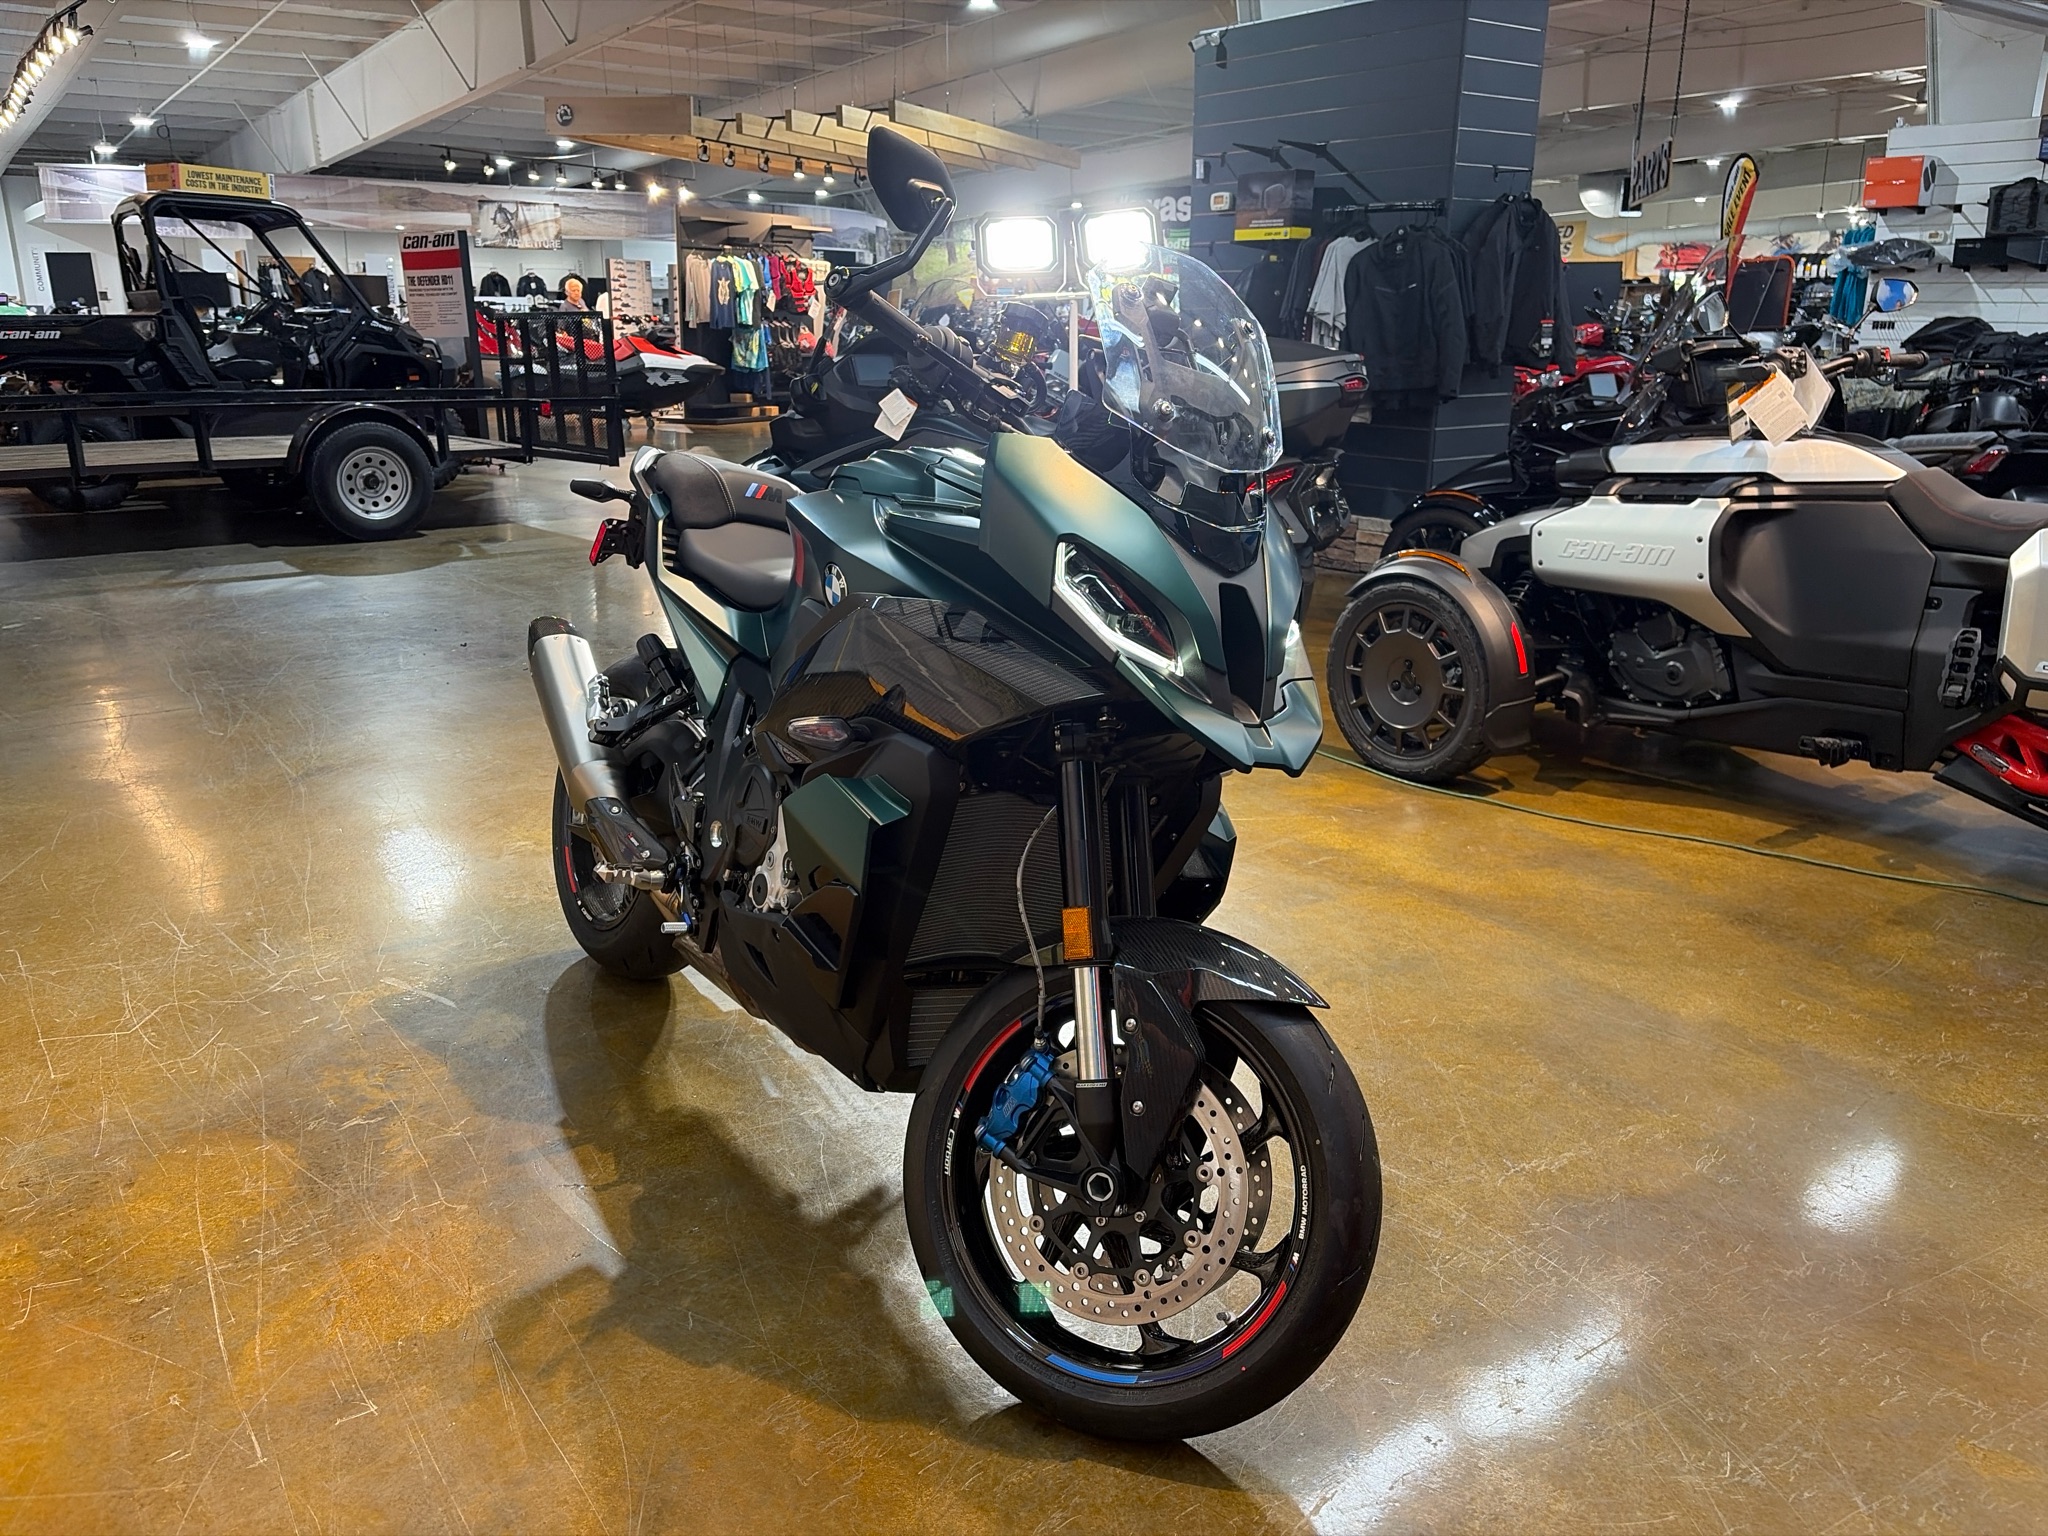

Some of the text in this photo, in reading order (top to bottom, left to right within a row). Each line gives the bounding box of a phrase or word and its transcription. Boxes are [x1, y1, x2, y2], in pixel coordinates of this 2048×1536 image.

[187, 170, 262, 186] LOWEST MAINTENANCE
[1630, 140, 1672, 202] PARTS
[185, 179, 208, 189] COSTS
[208, 181, 216, 190] IN
[217, 182, 231, 191] THE
[231, 183, 265, 195] INDUSTRY.
[1724, 167, 1752, 237] SALE EVENT
[403, 233, 456, 249] can-am
[506, 238, 562, 249] ADVENTURE
[0, 330, 61, 340] can-am
[1558, 538, 1675, 566] can-am
[944, 1128, 956, 1177] Carbon
[1300, 1165, 1309, 1216] MOTORRAD
[1298, 1217, 1307, 1240] BMW
